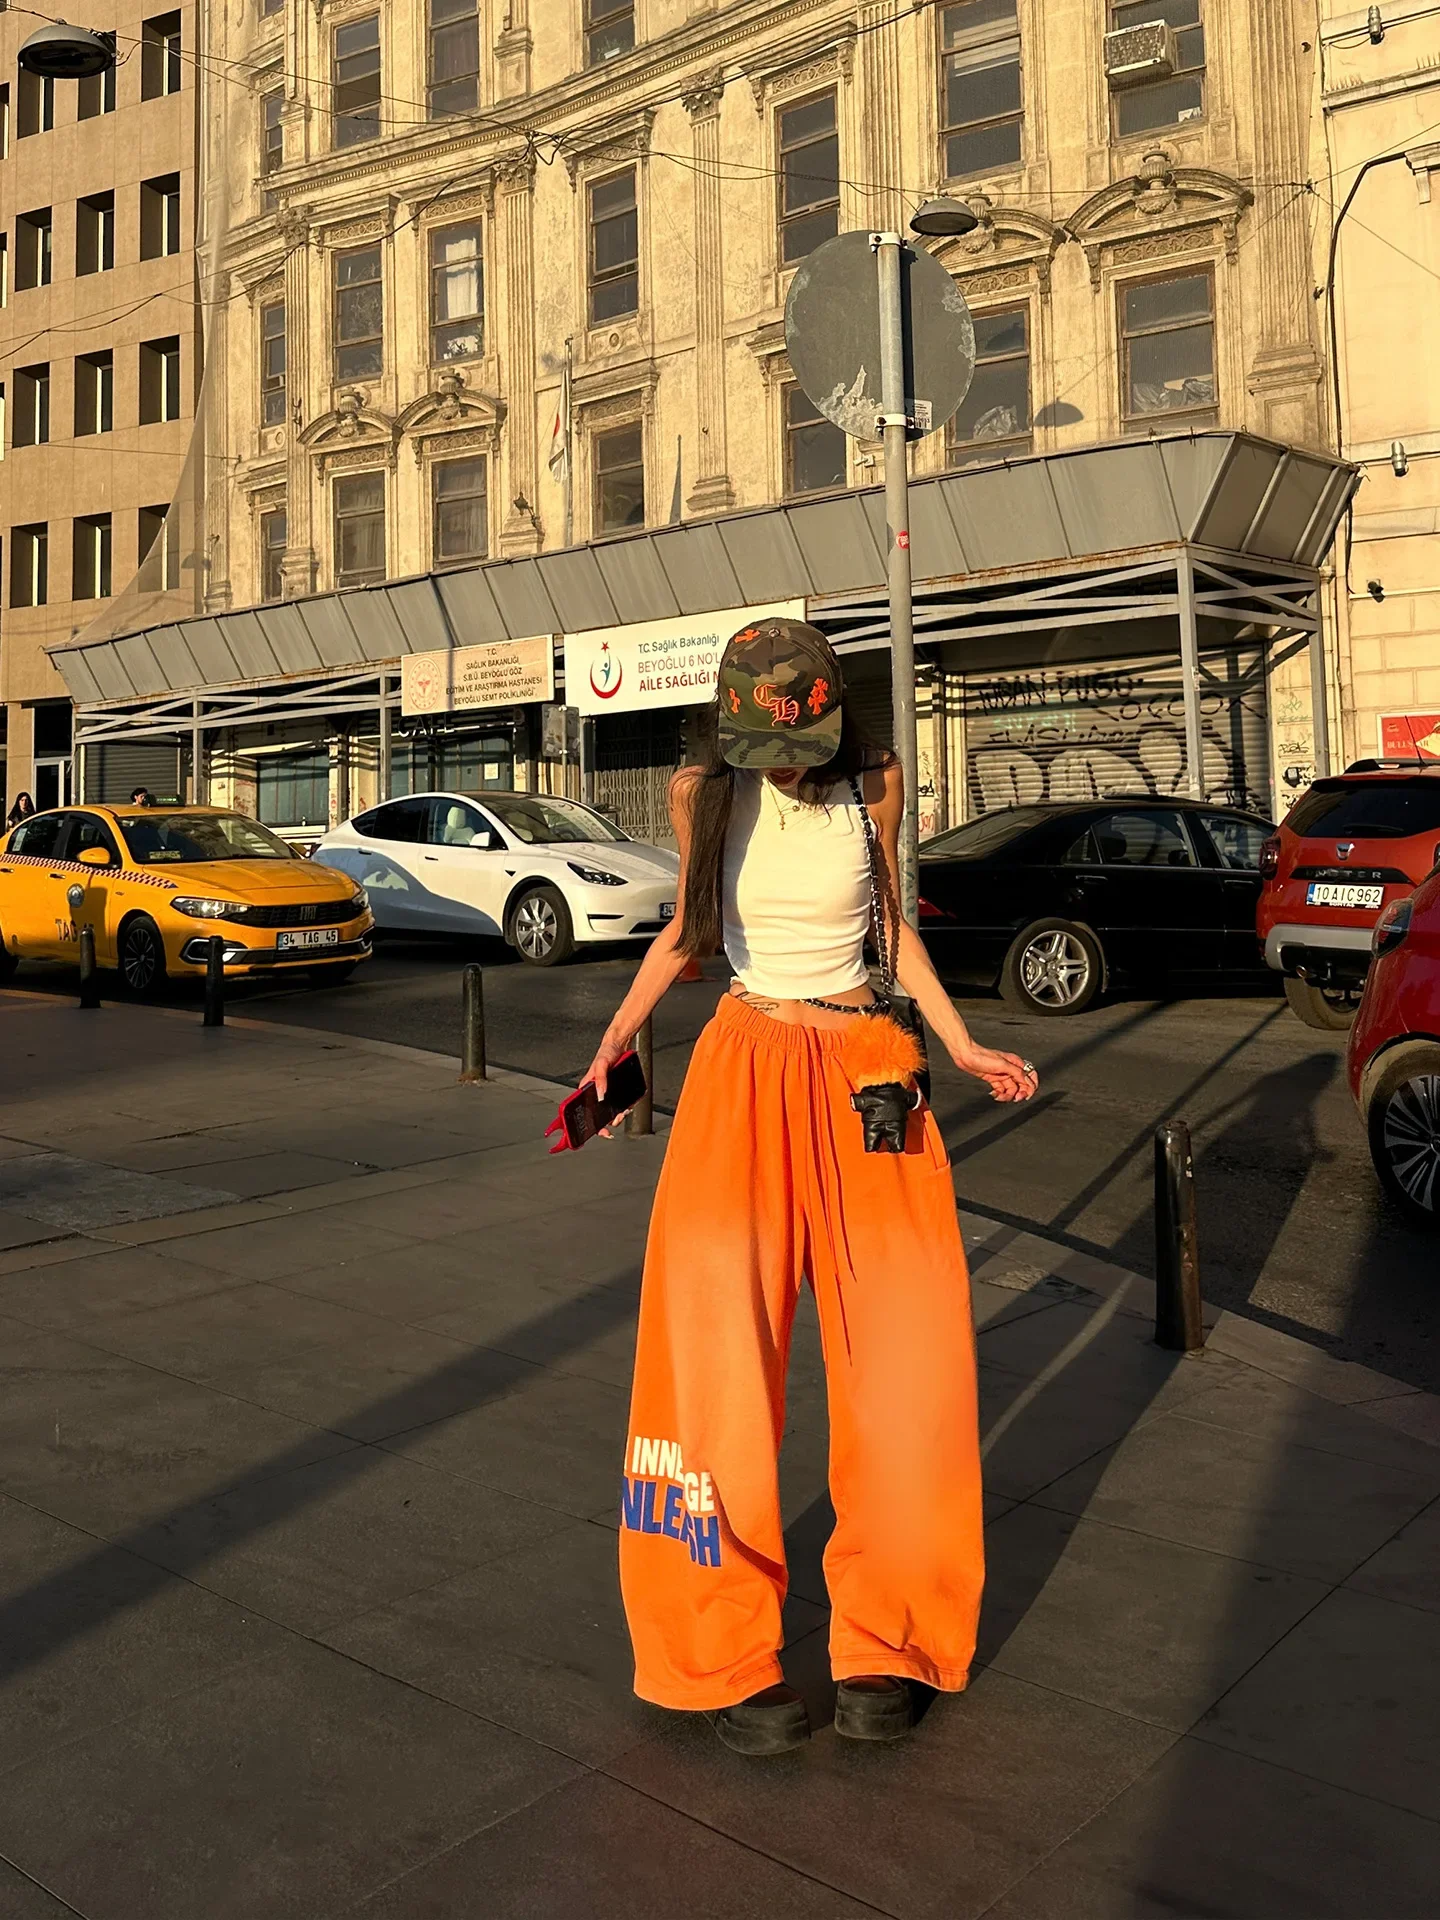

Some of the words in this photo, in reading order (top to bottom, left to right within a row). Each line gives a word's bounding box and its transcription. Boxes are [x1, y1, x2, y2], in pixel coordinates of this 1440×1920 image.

[652, 639, 678, 653] Sağlık
[679, 633, 720, 648] Bakanlığı
[465, 659, 487, 671] SAĞLIK
[487, 656, 520, 668] BAKANLIĞI
[637, 656, 686, 674] BEYOĞLU
[688, 654, 695, 667] 6
[697, 651, 723, 666] NO'L
[480, 668, 509, 680] BEYOĞLU
[508, 667, 523, 676] GÖZ
[639, 678, 663, 692] AİLE
[665, 669, 710, 688] SAĞLIĞI
[445, 685, 465, 695] EĞİTİM
[465, 684, 473, 693] VE
[474, 679, 508, 692] ARAŞTIRMA
[454, 695, 481, 706] BEYOĞLU
[481, 693, 498, 702] SEMT
[55, 918, 79, 943] TAG
[283, 934, 295, 946] 34
[302, 932, 320, 944] TAG
[325, 930, 337, 942] 45
